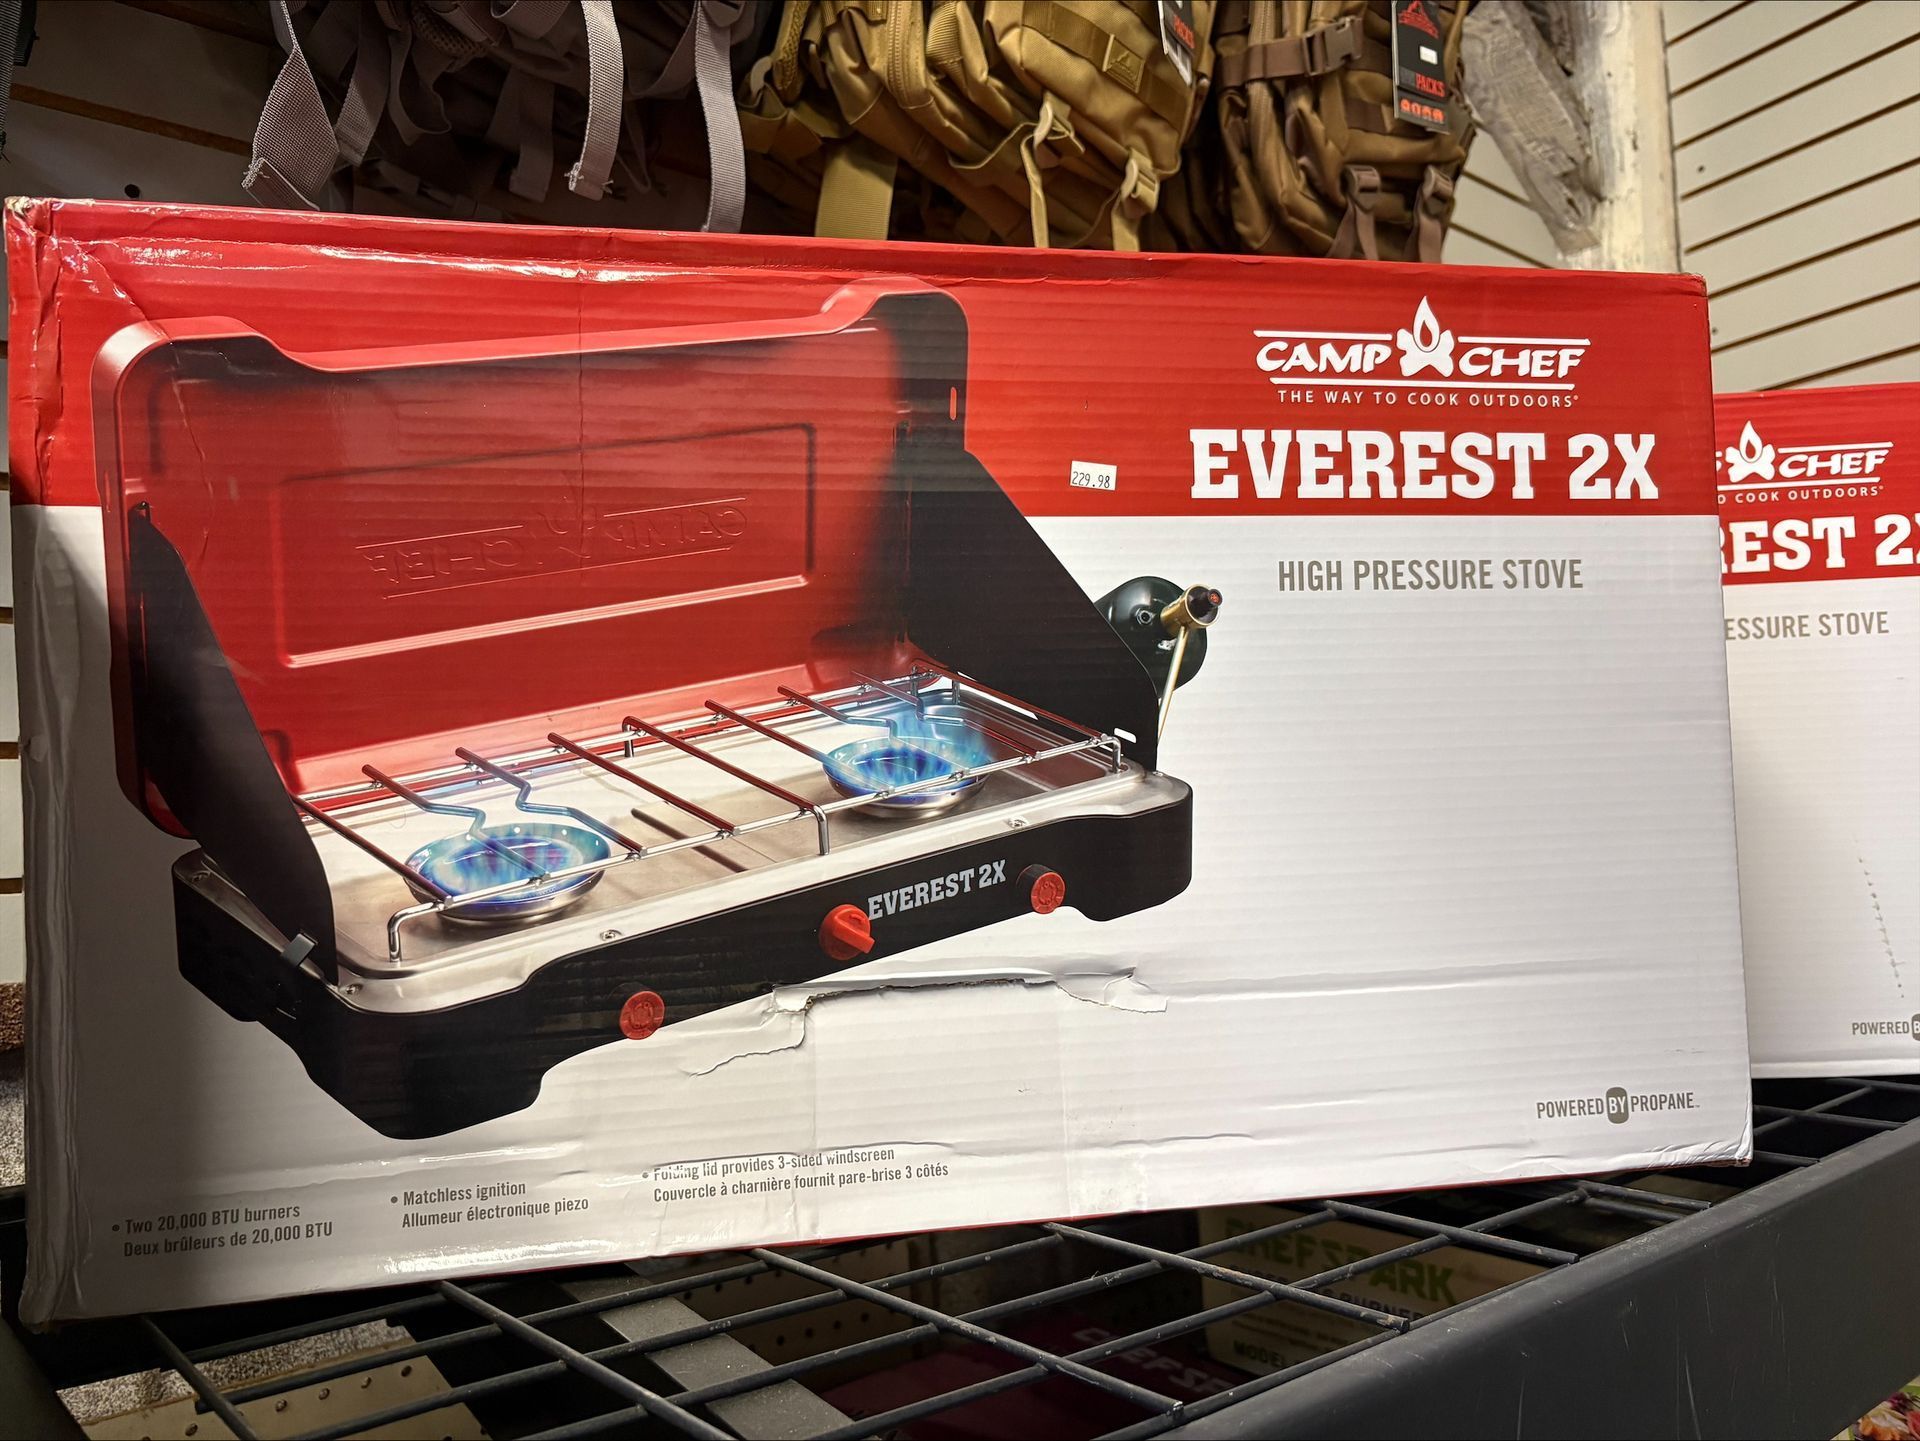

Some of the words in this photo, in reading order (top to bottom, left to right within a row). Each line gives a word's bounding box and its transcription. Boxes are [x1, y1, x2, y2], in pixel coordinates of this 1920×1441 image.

[1415, 73, 1445, 97] PACKS
[1255, 340, 1392, 375] CAMP
[1459, 343, 1586, 379] CHEF
[1278, 389, 1315, 404] THE
[1324, 390, 1364, 405] WAY
[1372, 390, 1397, 405] TO
[1407, 391, 1460, 406] COOK
[1189, 428, 1546, 500] EVEREST
[1568, 432, 1659, 500] 2X
[1778, 449, 1890, 478] CHEF
[1071, 470, 1110, 488] 229.98
[1735, 491, 1780, 503] COOK
[1278, 559, 1342, 591] HIGH
[1353, 558, 1494, 590] PRESSURE
[1503, 557, 1584, 589] STOVE
[1725, 614, 1810, 640] ESSURE
[1819, 610, 1890, 637] STOVE
[867, 868, 975, 921] EVEREST
[978, 858, 1007, 889] 2X
[1851, 1021, 1909, 1036] POWERED
[1536, 1097, 1604, 1119] POWERED
[1608, 1095, 1627, 1115] BY
[703, 1162, 718, 1177] lid
[722, 1158, 775, 1178] provides
[778, 1154, 823, 1169] 3-sided
[827, 1149, 895, 1165] windscreen
[403, 1187, 472, 1206] Matchless
[476, 1181, 526, 1201] ignition
[654, 1183, 717, 1202] Couvercle
[720, 1181, 728, 1195] à
[732, 1176, 791, 1194] charnière
[794, 1172, 835, 1189] fournit
[838, 1166, 901, 1187] pare-brise
[905, 1165, 912, 1179] 3
[916, 1162, 949, 1179] côtés
[125, 1219, 153, 1234] Two
[157, 1211, 207, 1232] 20,000
[212, 1208, 240, 1226] BTU
[244, 1205, 301, 1222] burners
[402, 1209, 463, 1228] Allumeur
[467, 1200, 550, 1221] électronique
[554, 1197, 589, 1216] piezo
[124, 1241, 160, 1257] Deux
[164, 1234, 225, 1253] brûleurs
[230, 1231, 247, 1247] de
[252, 1225, 301, 1245] 20,000
[305, 1221, 333, 1239] BTU
